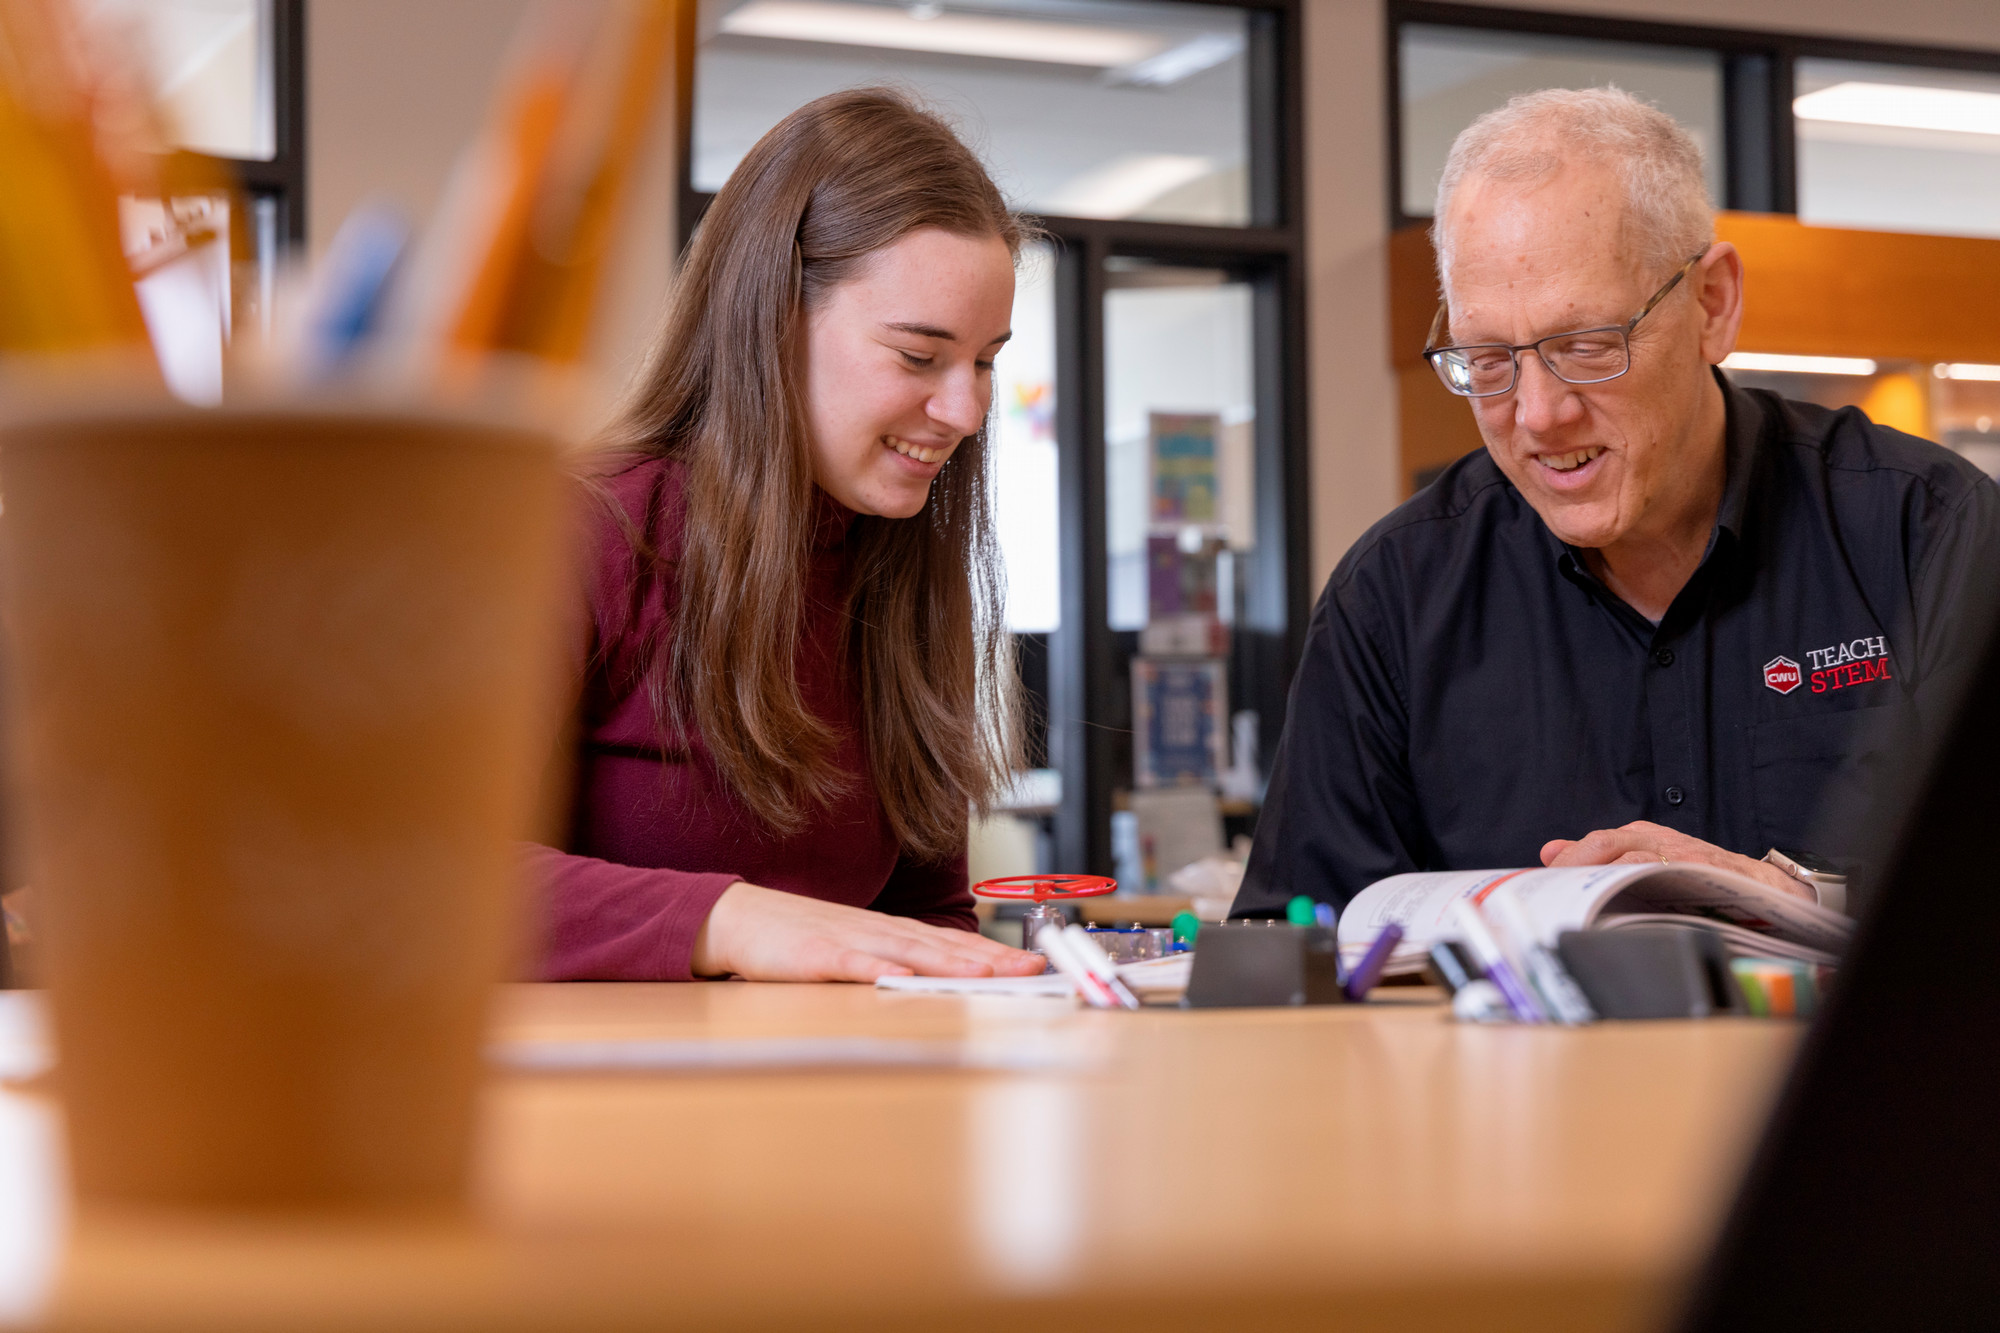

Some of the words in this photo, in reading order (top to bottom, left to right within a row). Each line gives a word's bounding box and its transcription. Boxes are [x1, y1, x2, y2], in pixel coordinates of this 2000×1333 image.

[1806, 636, 1888, 670] TEACH
[1767, 672, 1798, 683] CWU
[1810, 657, 1892, 694] STEM
